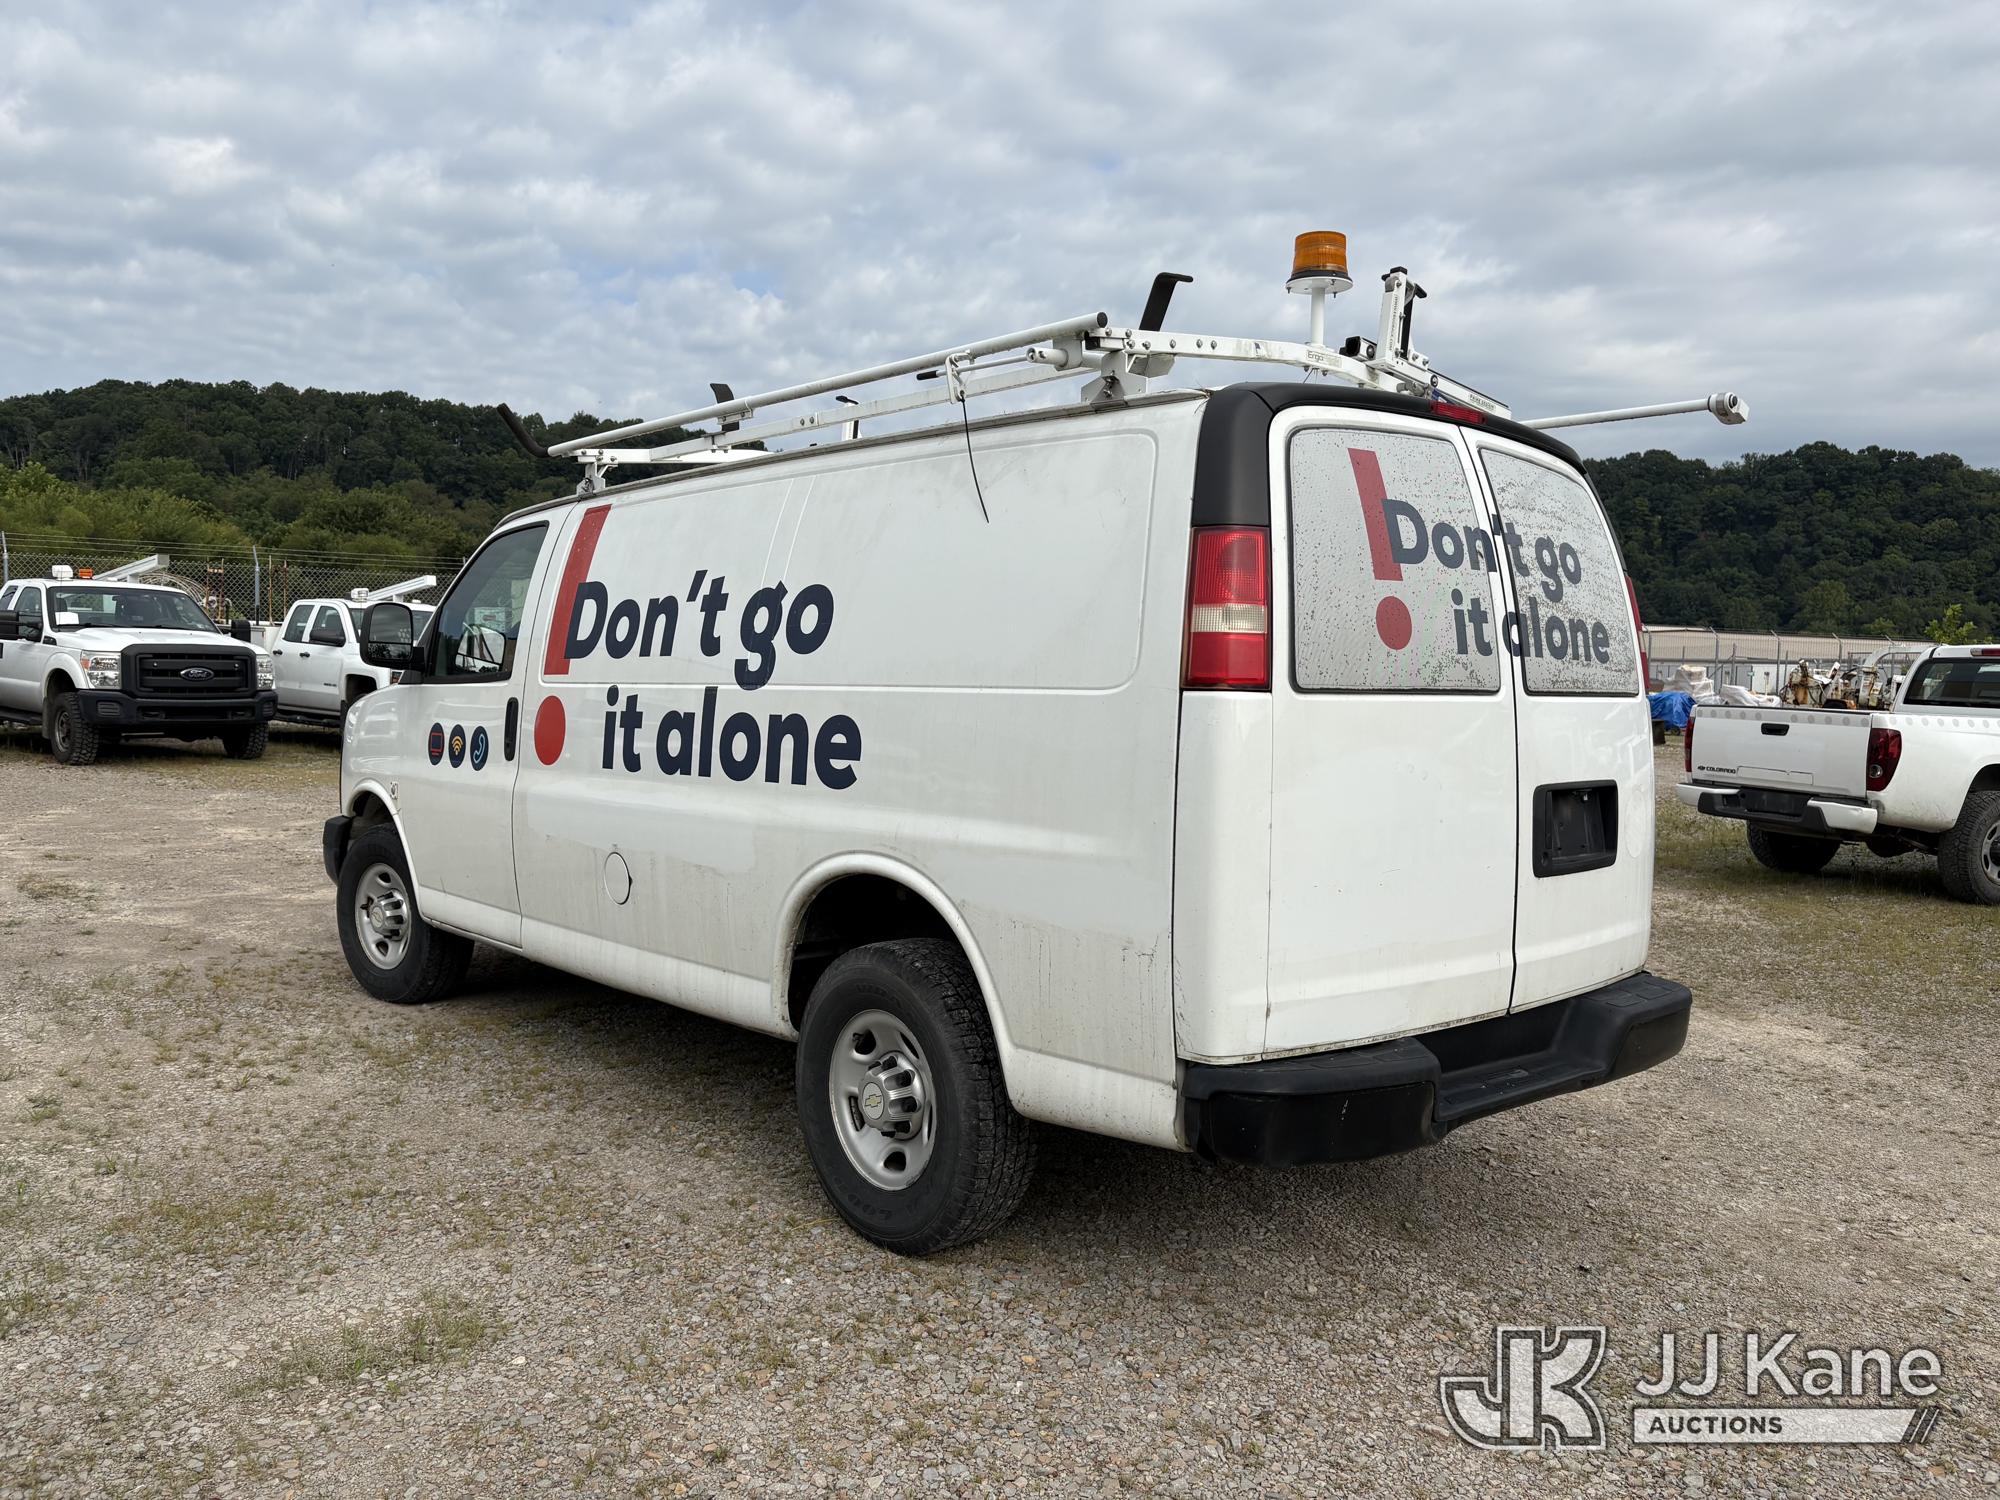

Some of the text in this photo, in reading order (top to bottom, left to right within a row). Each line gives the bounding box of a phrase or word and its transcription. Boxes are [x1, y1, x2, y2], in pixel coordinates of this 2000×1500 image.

[1382, 499, 1582, 603] Don't go
[564, 569, 834, 690] Don't go
[1452, 588, 1610, 665] it alone
[602, 685, 862, 790] it alone
